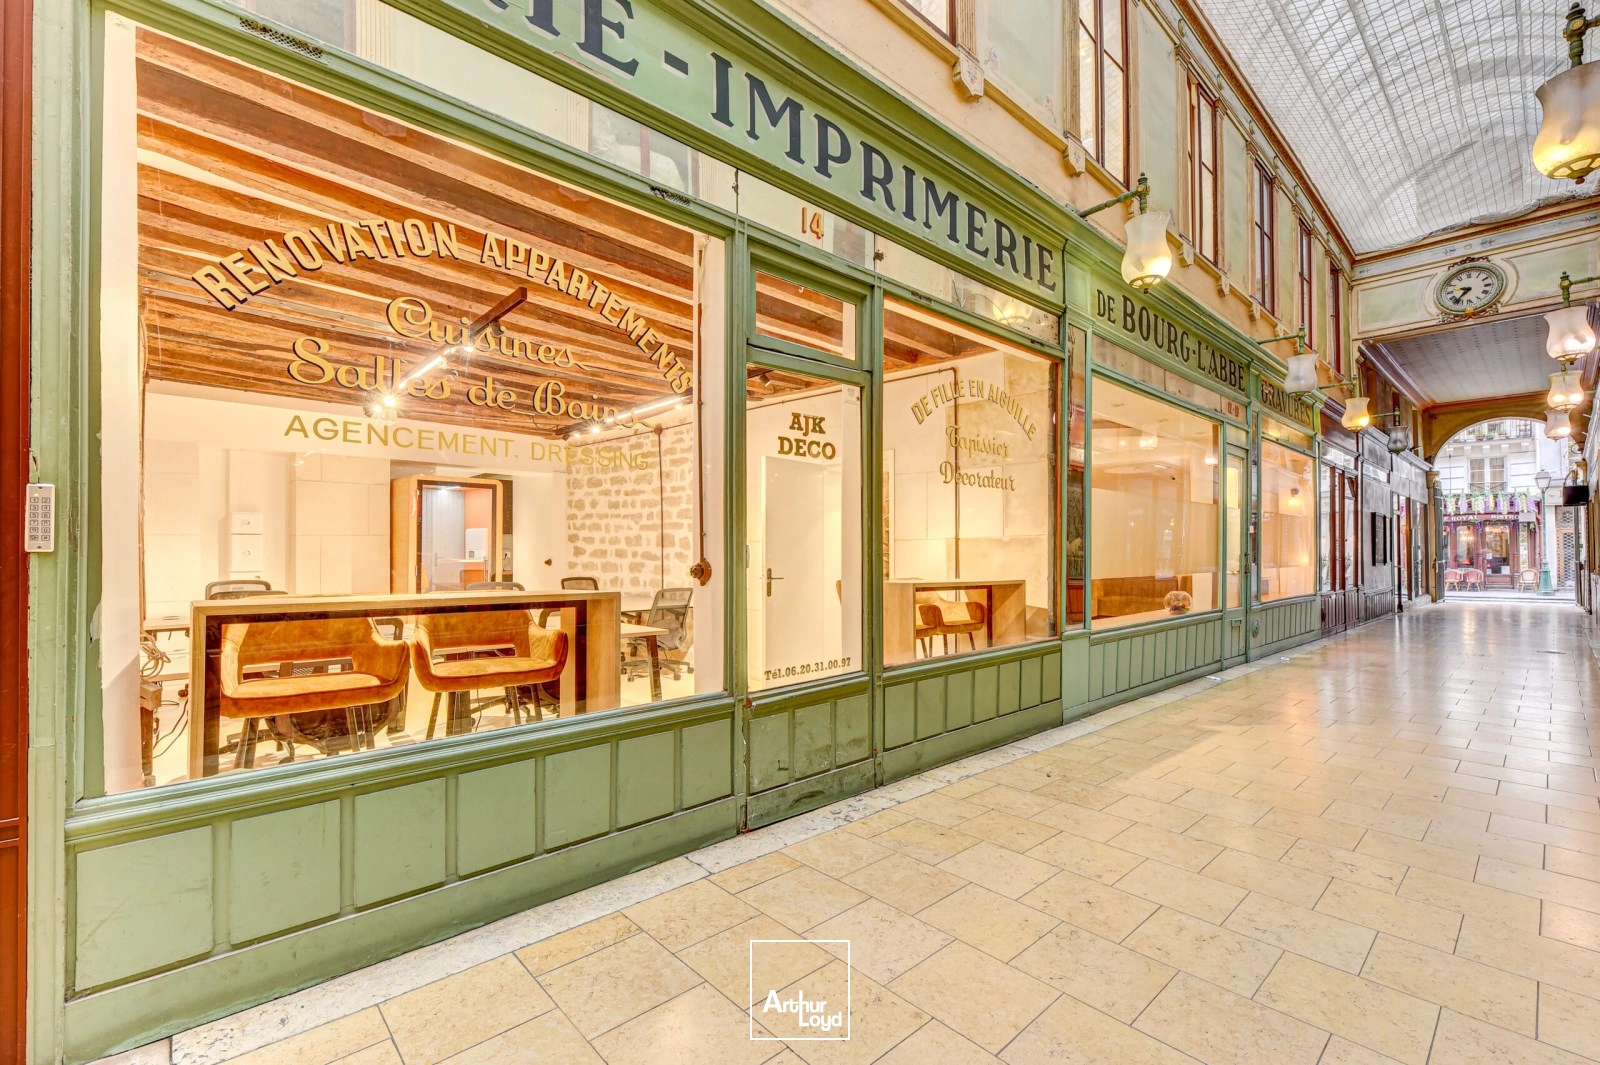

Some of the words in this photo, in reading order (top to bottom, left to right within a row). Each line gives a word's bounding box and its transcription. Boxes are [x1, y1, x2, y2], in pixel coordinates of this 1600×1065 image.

[710, 51, 1056, 292] IMPRIMERIE
[801, 205, 825, 240] 14
[191, 217, 460, 312] RENOVATION
[480, 232, 693, 394] APPARTEMENTS
[386, 296, 596, 371] Cuisines
[1096, 288, 1116, 325] DE
[287, 335, 452, 401] Salles
[468, 376, 518, 411] de
[788, 411, 827, 437] AJK
[911, 394, 933, 425] DE
[931, 379, 966, 408] FILLE
[968, 379, 984, 399] EN
[987, 383, 1037, 442] AIGUILLE
[283, 413, 519, 462] AGENCEMENT,
[531, 441, 649, 472] DRESSING
[777, 435, 837, 460] DECO
[945, 425, 1009, 459] Tapissier
